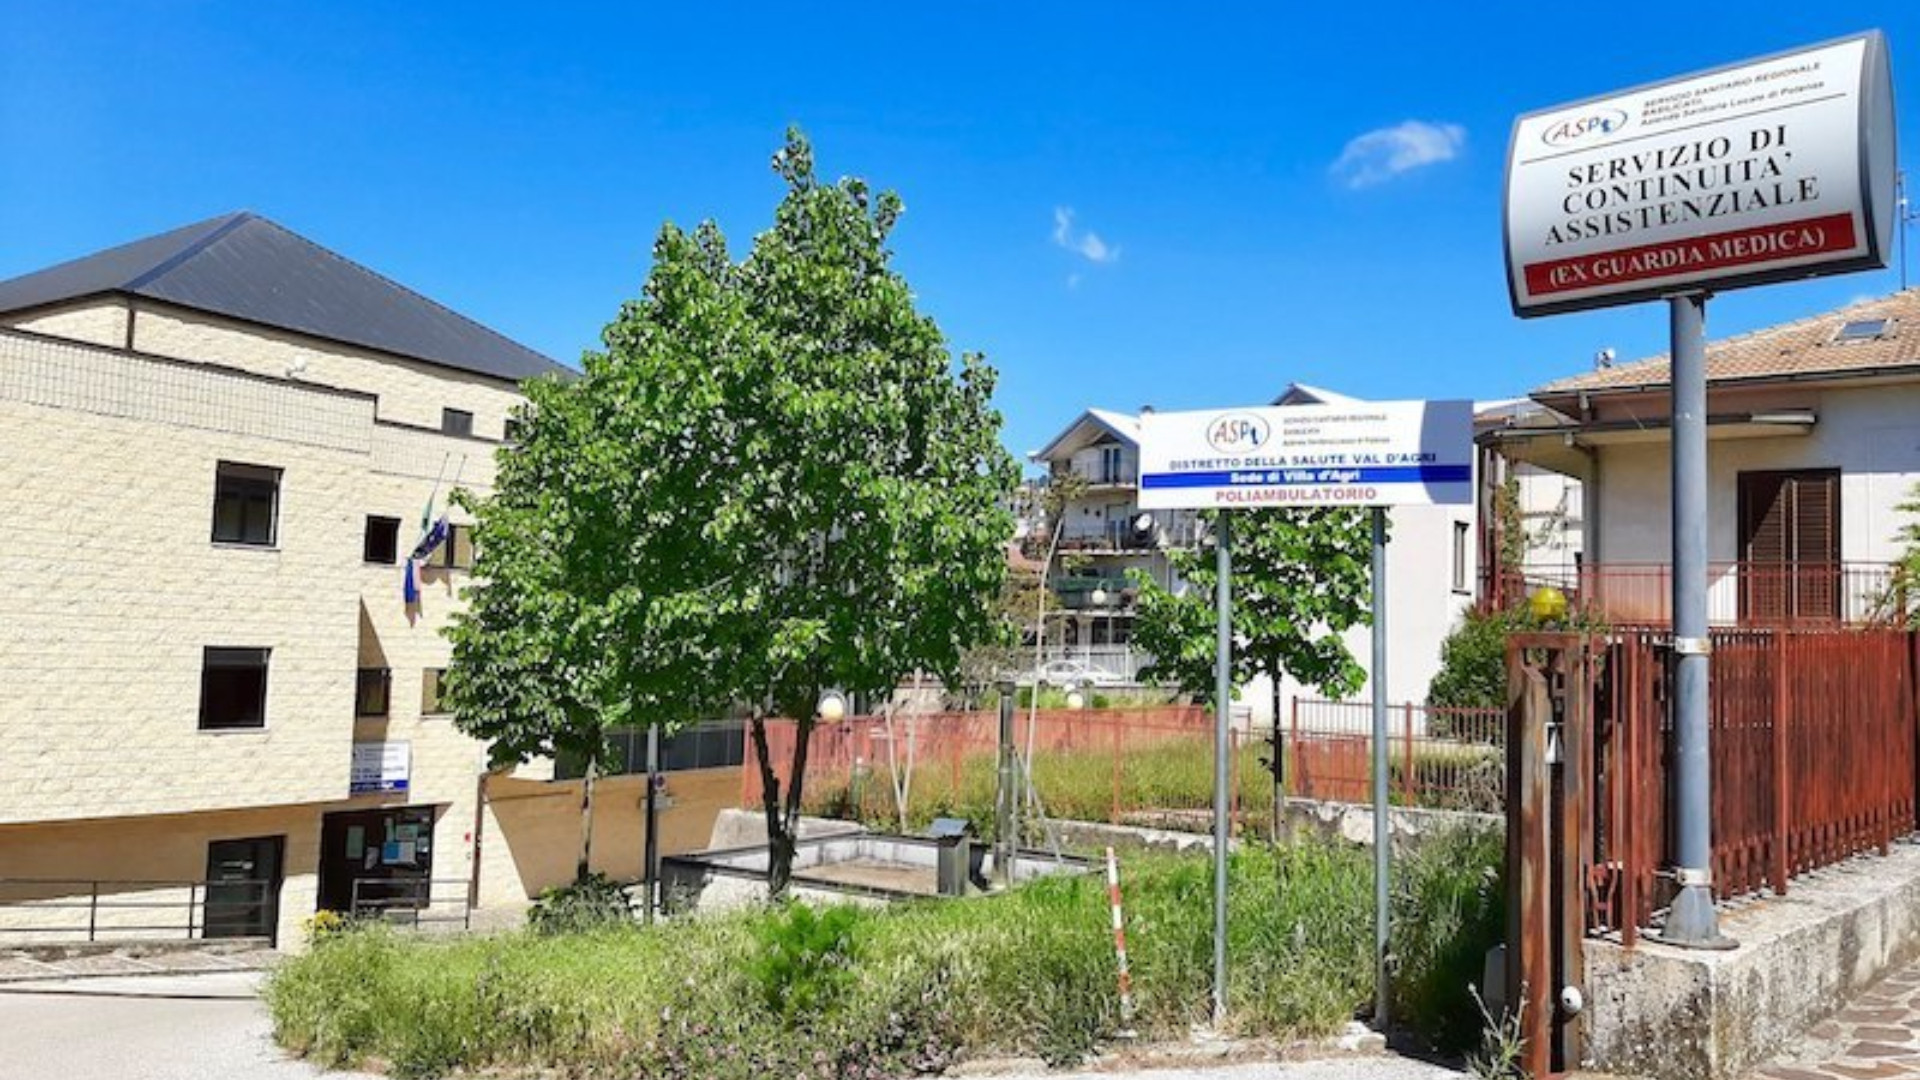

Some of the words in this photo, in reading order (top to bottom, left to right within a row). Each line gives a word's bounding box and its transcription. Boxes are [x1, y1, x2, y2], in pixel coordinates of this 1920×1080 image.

[1563, 151, 1792, 214] CONTINUITA'
[1567, 136, 1731, 188] SERVIZIO
[1750, 124, 1787, 152] DI
[1544, 176, 1820, 245] ASSISTENZIALE
[1550, 264, 1588, 287] (EX
[1592, 247, 1703, 278] GUARDIA
[1710, 227, 1826, 260] MEDICA)
[1169, 458, 1241, 471] DISTRETTO
[1245, 456, 1287, 467] DELLA
[1292, 454, 1344, 466] SALUTE
[1353, 453, 1381, 464] VAL
[1386, 452, 1436, 464] D'AGRI
[1230, 471, 1264, 484] Sede
[1267, 470, 1280, 483] di
[1283, 469, 1315, 483] Villa
[1318, 468, 1360, 484] d'Agri
[1216, 486, 1377, 502] POLIAMBULATORIO
